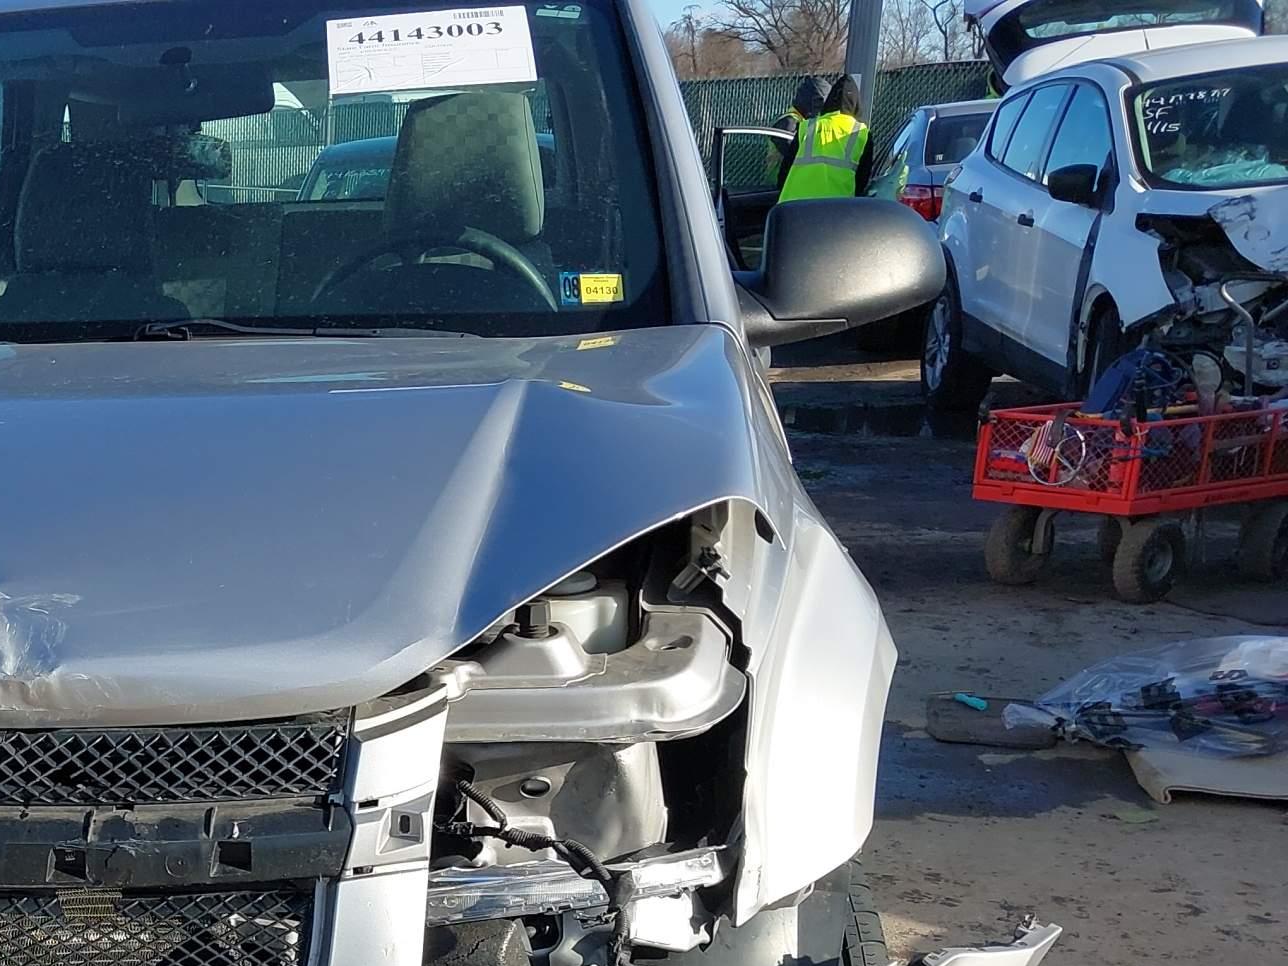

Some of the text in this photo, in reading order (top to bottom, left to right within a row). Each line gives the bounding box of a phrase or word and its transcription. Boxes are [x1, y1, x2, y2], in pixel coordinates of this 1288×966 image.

[348, 21, 504, 45] 44143003
[1144, 105, 1173, 119] SF
[1147, 120, 1181, 134] 1/15
[585, 286, 618, 295] 04130
